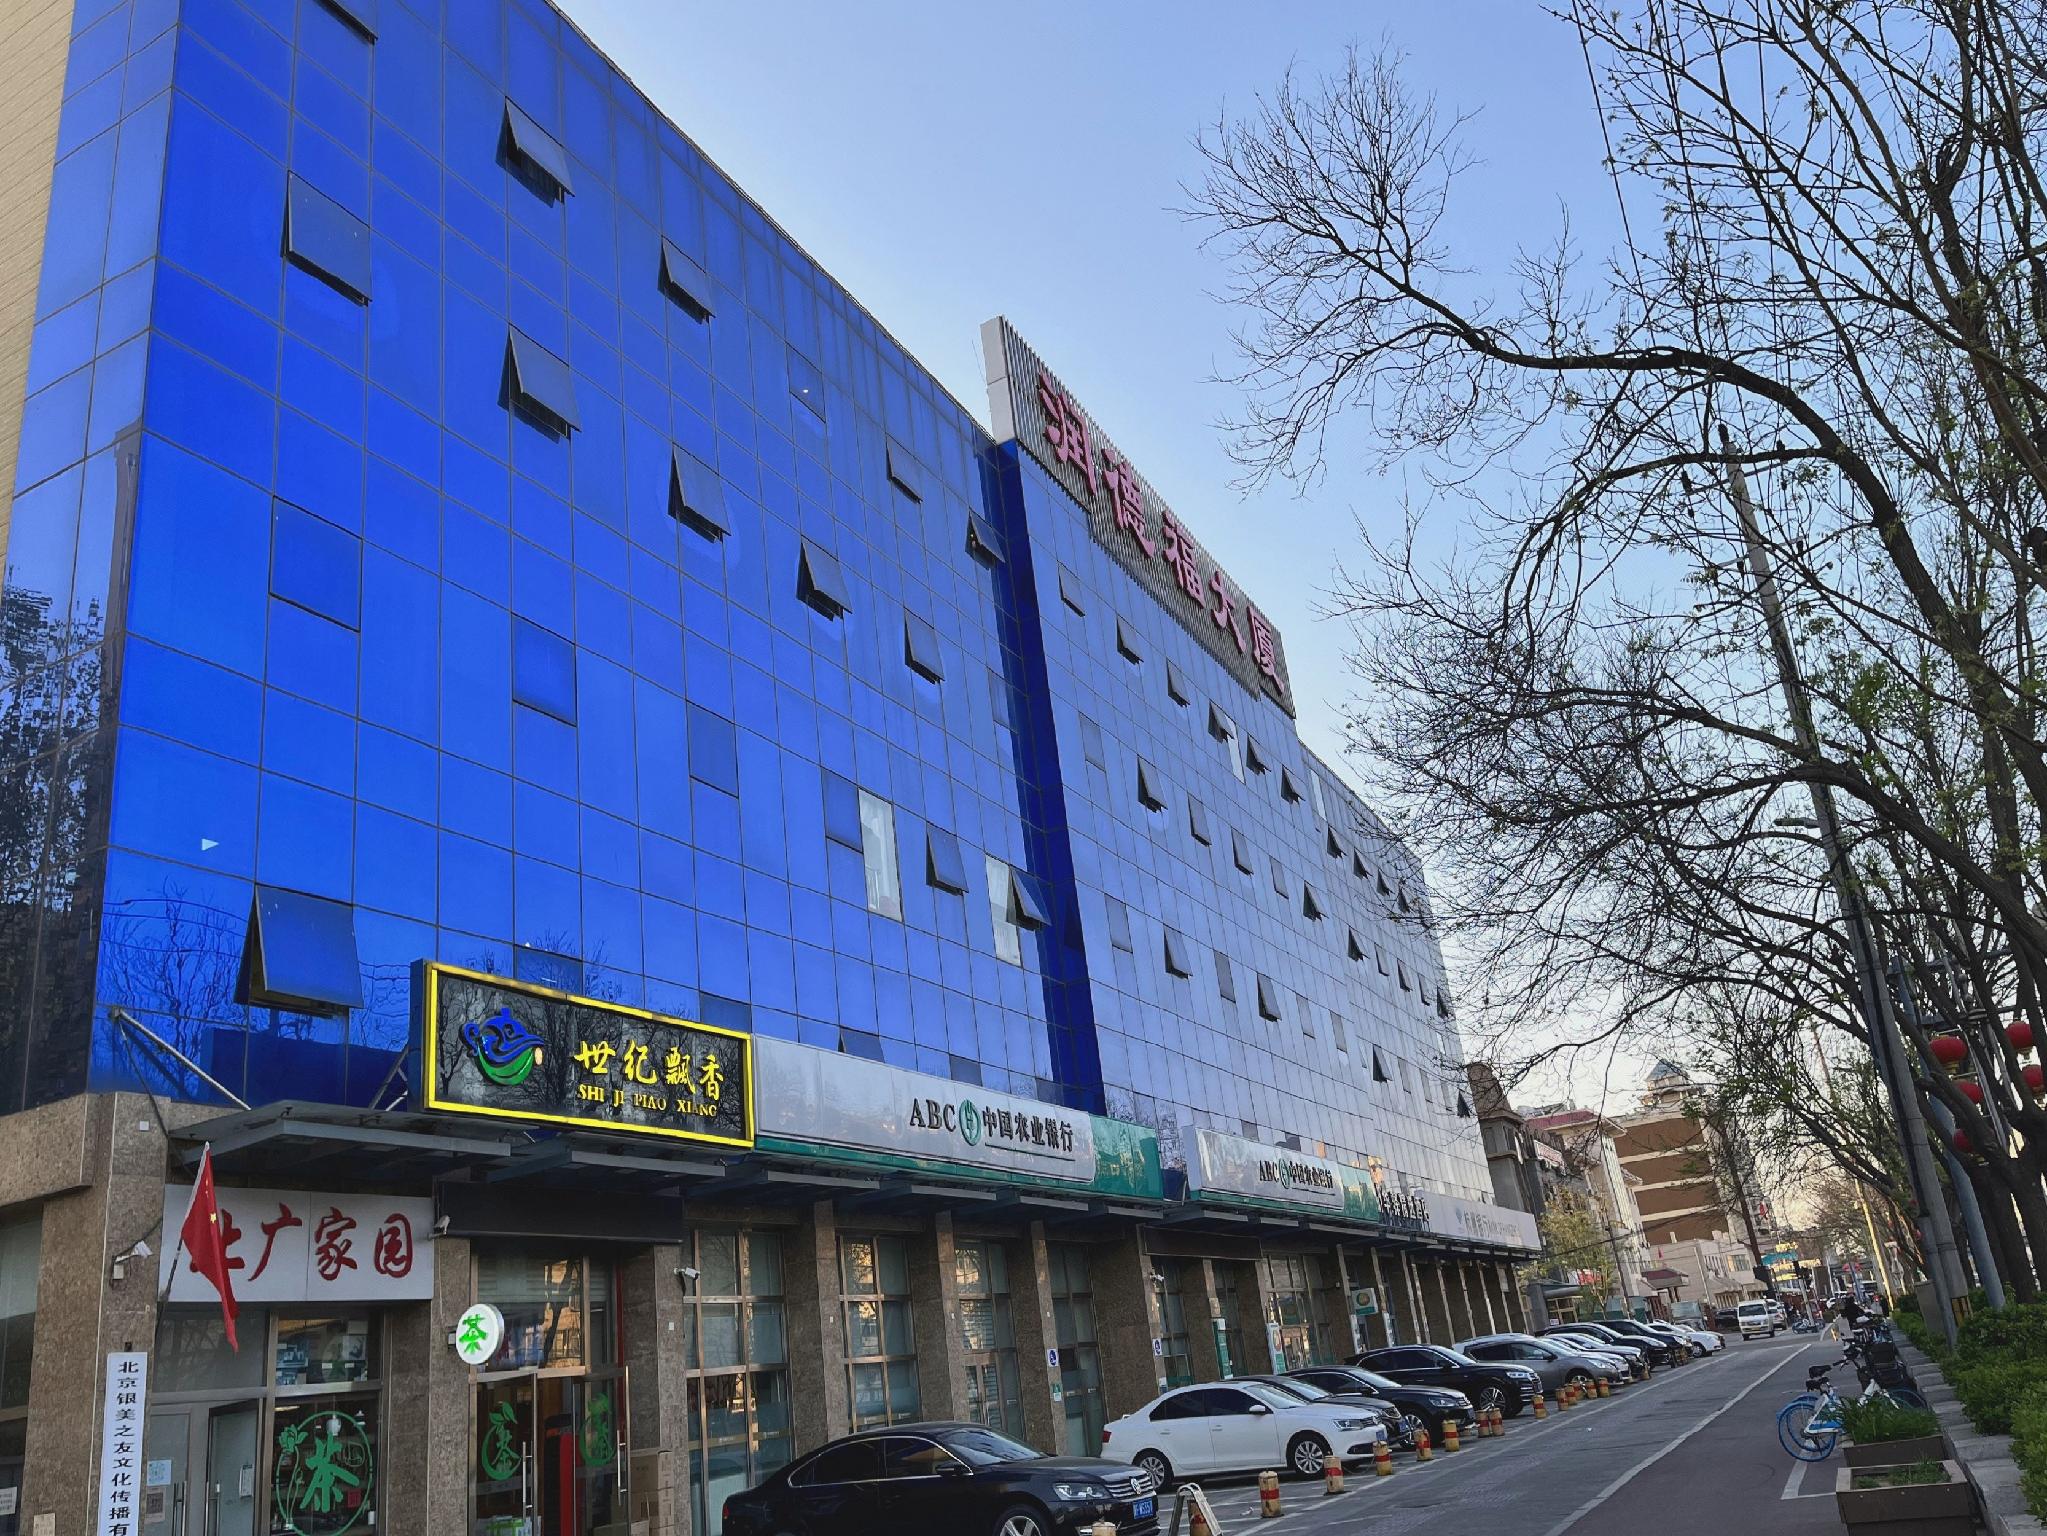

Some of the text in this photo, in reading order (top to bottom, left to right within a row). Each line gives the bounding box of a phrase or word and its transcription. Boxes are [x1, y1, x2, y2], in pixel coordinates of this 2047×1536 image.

[1038, 372, 1285, 696] 润德福大厦
[578, 1083, 717, 1117] SHI JI PIAO XIANG
[909, 1098, 1074, 1153] ABC 中国农业银行
[1259, 1160, 1280, 1183] ABC
[459, 1314, 488, 1355] 茶
[109, 1361, 139, 1536] 北京银美之友文化传播有
[300, 1431, 360, 1513] 茶
